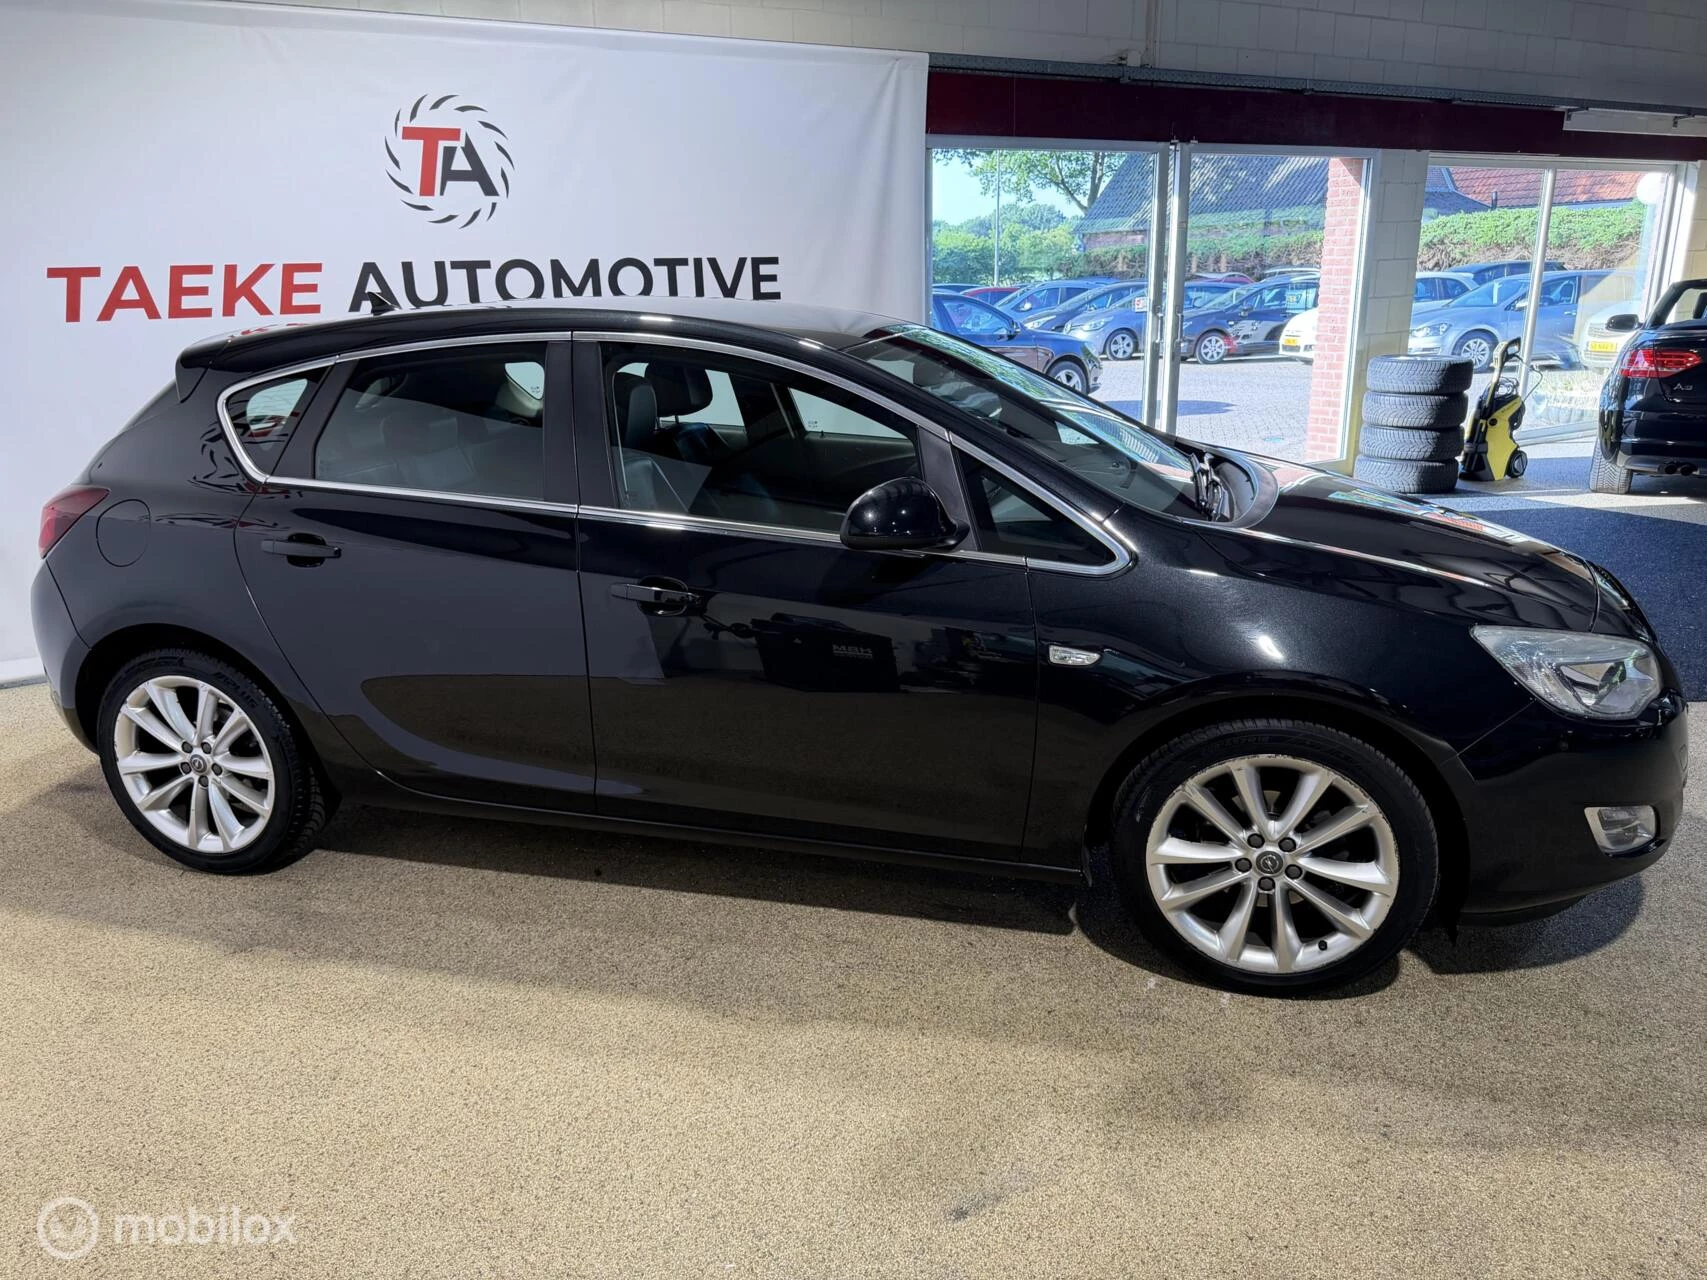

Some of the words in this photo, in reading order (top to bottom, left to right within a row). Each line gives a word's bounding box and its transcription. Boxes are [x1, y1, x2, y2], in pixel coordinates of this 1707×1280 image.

[402, 126, 500, 197] TA
[47, 263, 323, 323] TAEKE
[348, 256, 782, 312] AUTOMOTIVE
